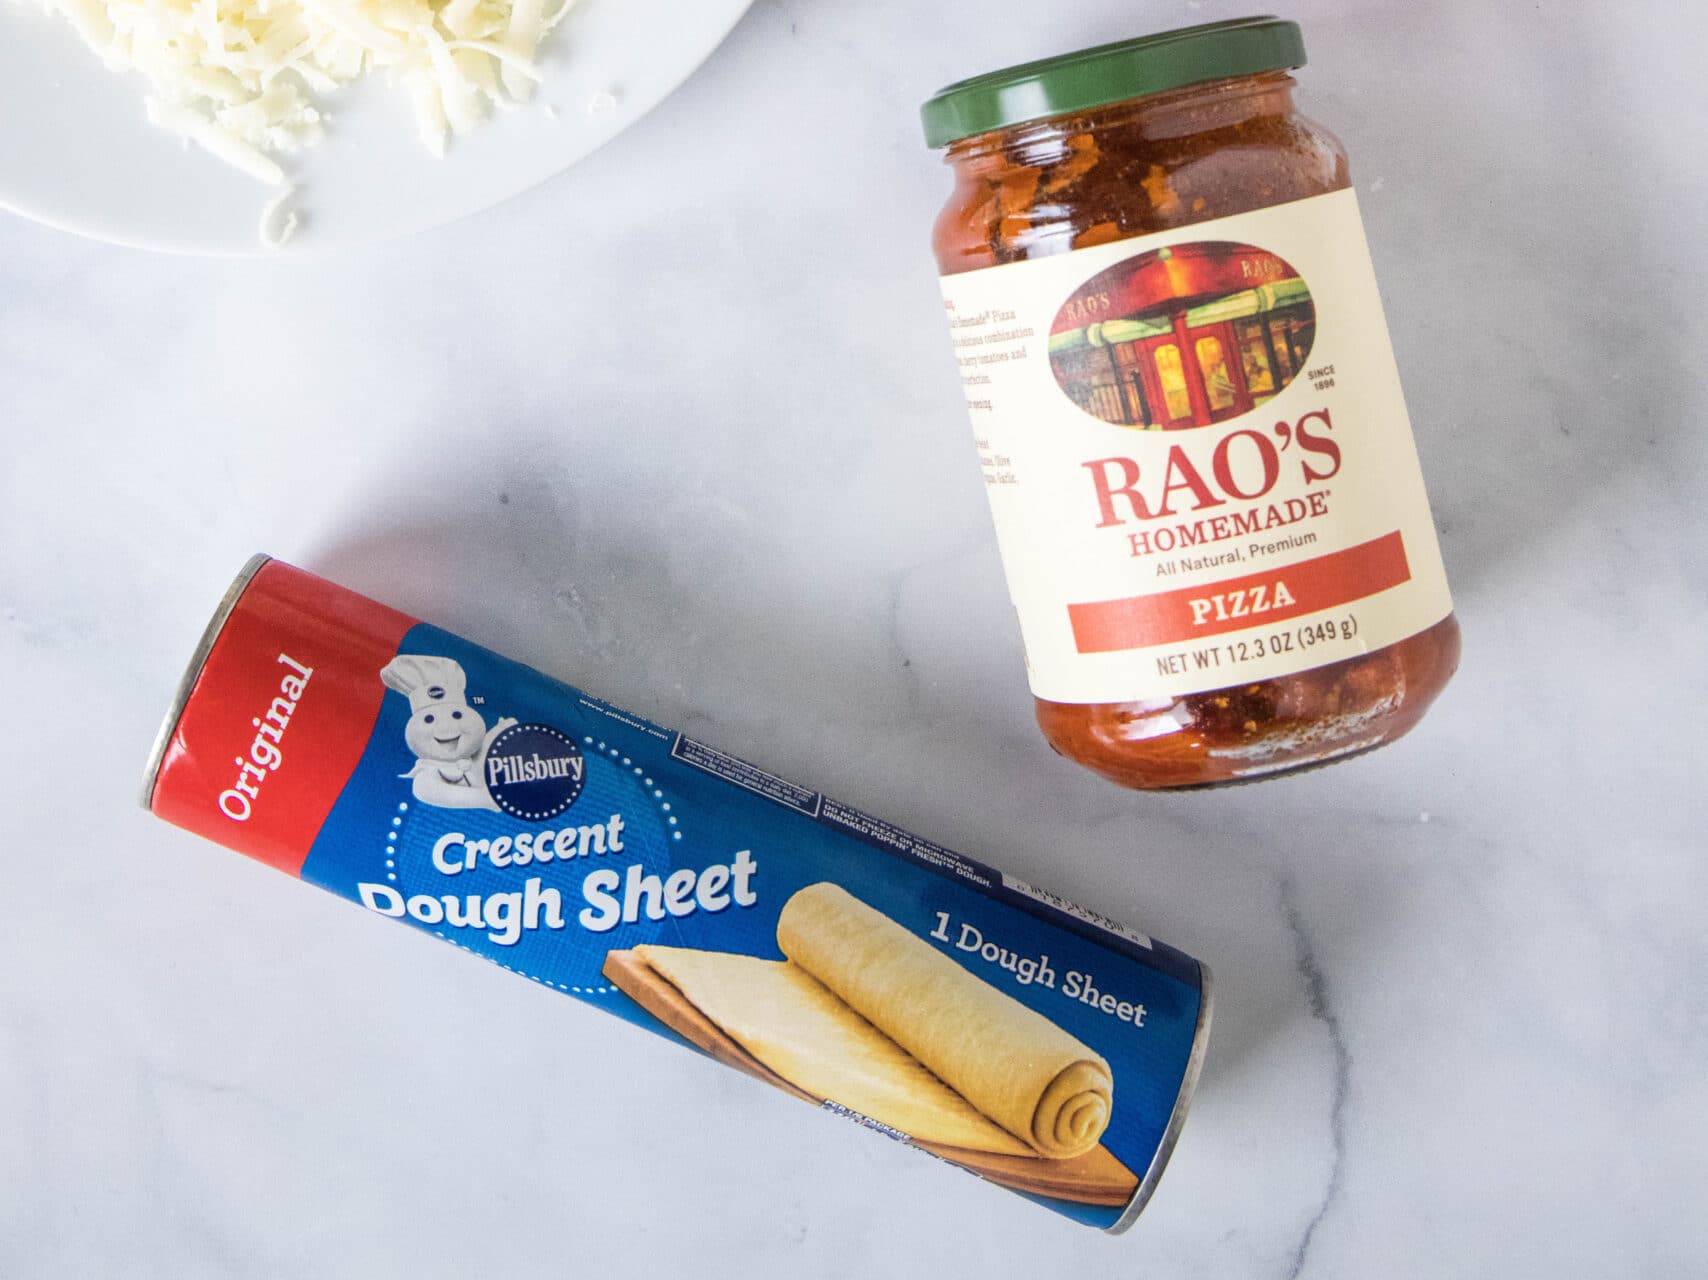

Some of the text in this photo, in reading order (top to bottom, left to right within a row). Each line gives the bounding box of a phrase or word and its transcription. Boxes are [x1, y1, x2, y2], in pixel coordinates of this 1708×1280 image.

[1307, 364, 1336, 381] SINCE
[1081, 407, 1343, 529] RAO’S
[1155, 529, 1318, 578] All Natural, Premium
[1188, 581, 1296, 625] PIZZA
[1156, 614, 1359, 677] NET WT 12.3 OZ (349 g)
[218, 652, 313, 823] Original
[486, 753, 585, 791] Pillsbury
[431, 813, 626, 875] Crescent
[357, 849, 758, 946] Dough Sheet
[929, 910, 952, 942] 1
[955, 925, 1056, 990] Dough
[1061, 968, 1148, 1029] Sheet
